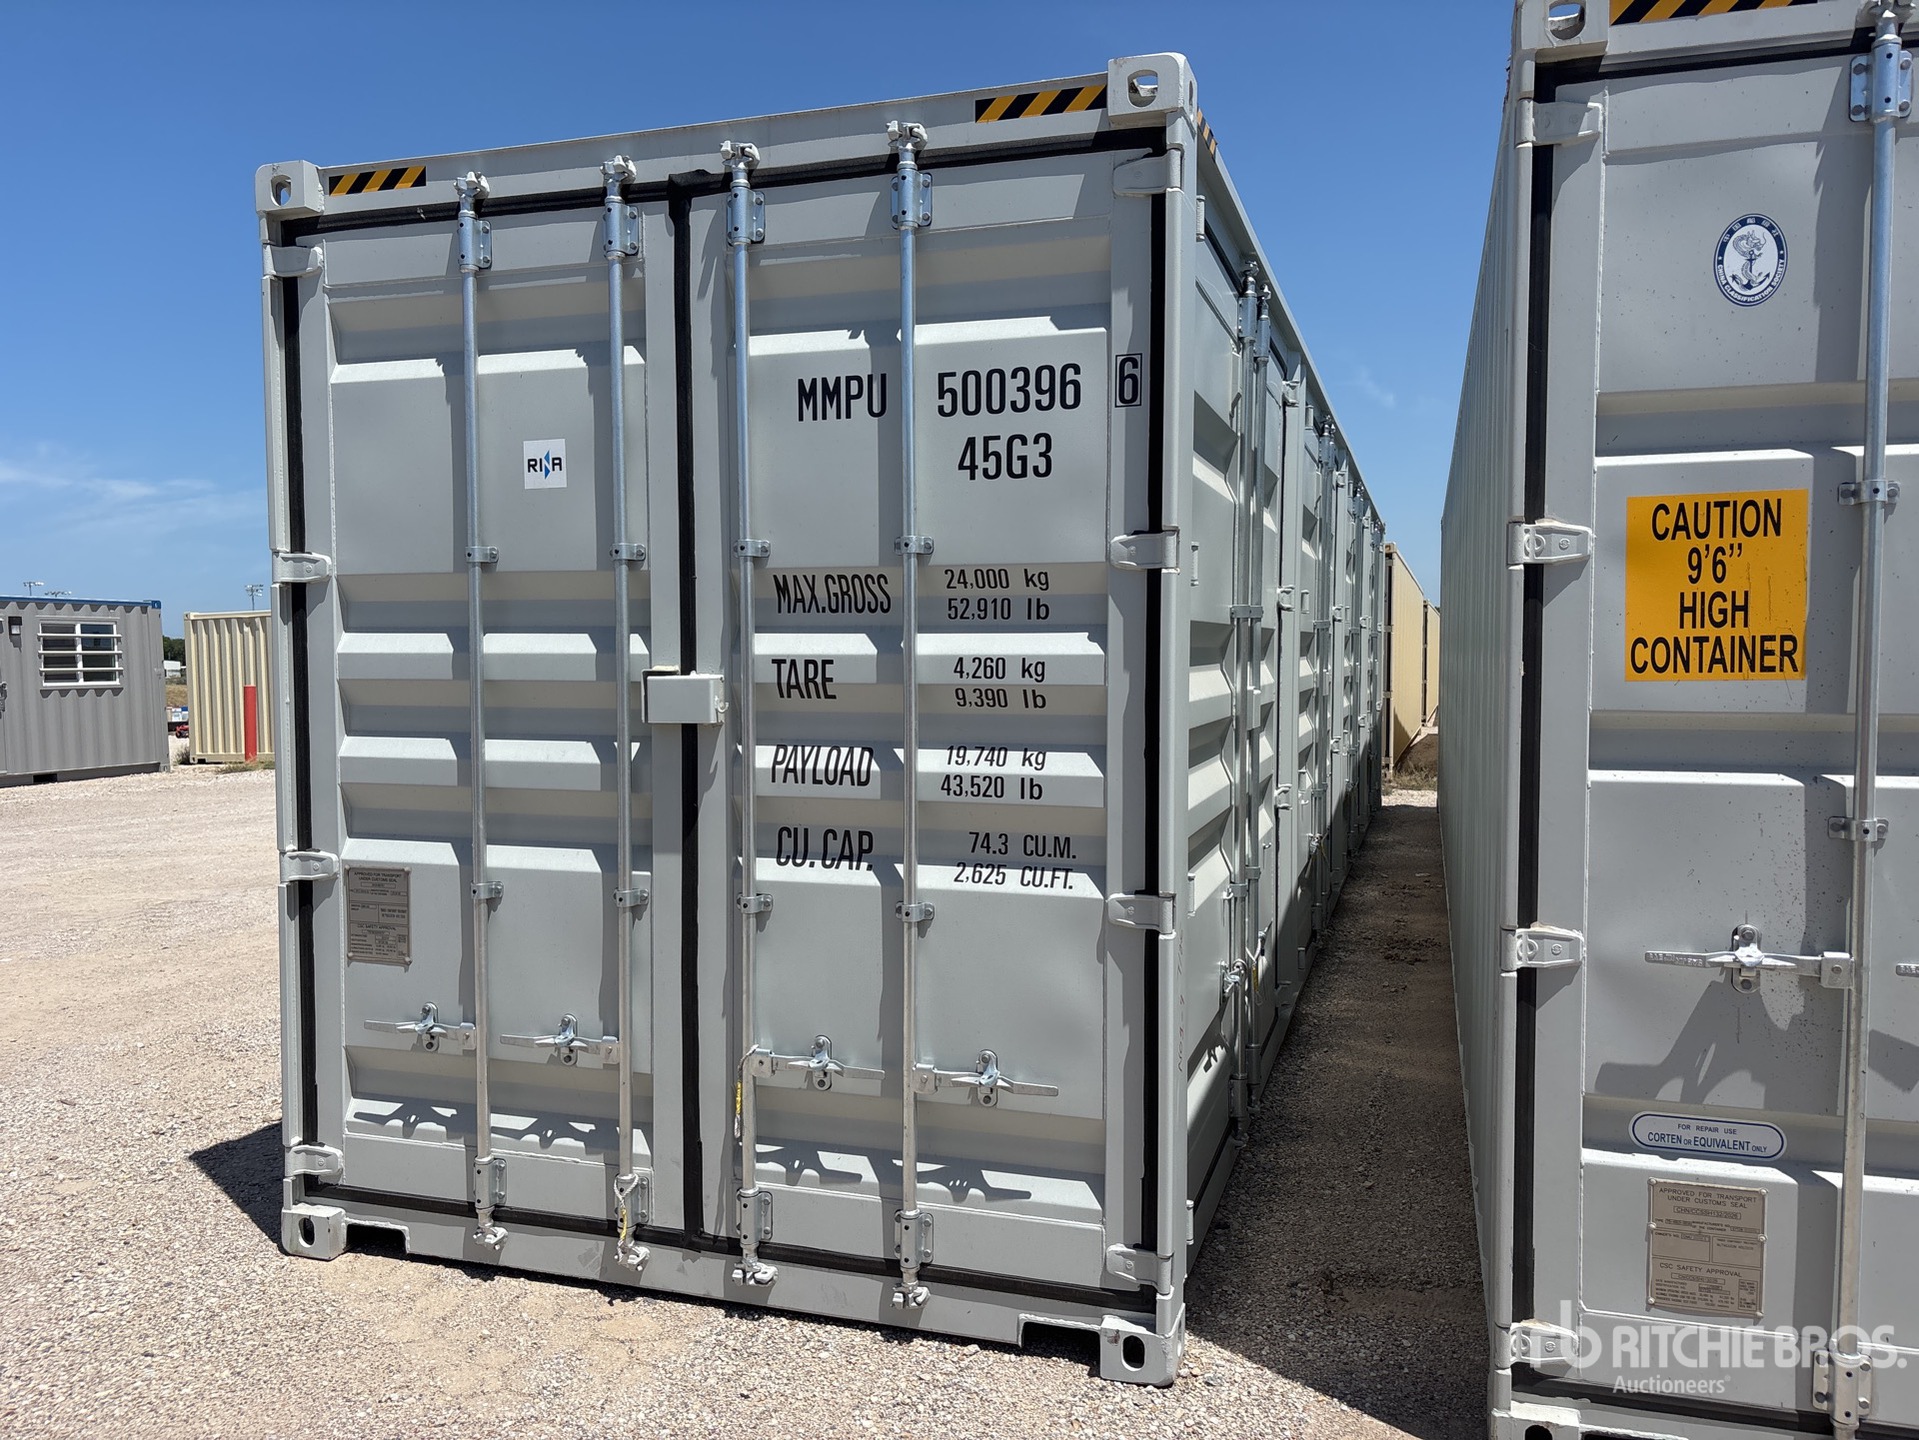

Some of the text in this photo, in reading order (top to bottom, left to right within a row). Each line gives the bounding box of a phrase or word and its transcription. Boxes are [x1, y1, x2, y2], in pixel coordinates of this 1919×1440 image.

[1718, 258, 1784, 302] CHINA CLASSIFICATION SOCIETY
[797, 356, 1139, 422] MMPU 500396 6
[957, 432, 1053, 481] 45G3
[1651, 498, 1782, 541] CAUTION
[1023, 568, 1050, 591] kg
[1026, 598, 1050, 621] lb
[1679, 590, 1749, 629] HIGH
[1630, 634, 1799, 674] CONTAINER
[771, 658, 837, 700] TARE
[1020, 657, 1046, 682] kg
[1022, 689, 1047, 709] lb
[770, 744, 874, 787] PAYLOAD
[1021, 747, 1047, 772] kg
[1019, 777, 1043, 800] lb
[968, 831, 1009, 855] 74.3
[1696, 1125, 1719, 1133] REPAIR
[1647, 1131, 1682, 1145] CORTEN
[1693, 1136, 1750, 1152] EQUIVALENT
[1751, 1145, 1767, 1153] ONLY
[1659, 1188, 1695, 1196] APPROVED
[1717, 1193, 1757, 1203] TRANSPORT
[1667, 1195, 1691, 1203] UNDER
[1694, 1198, 1727, 1207] CUSTOMS
[1676, 1264, 1703, 1273] SAFETY
[1706, 1268, 1742, 1278] APPROVAL
